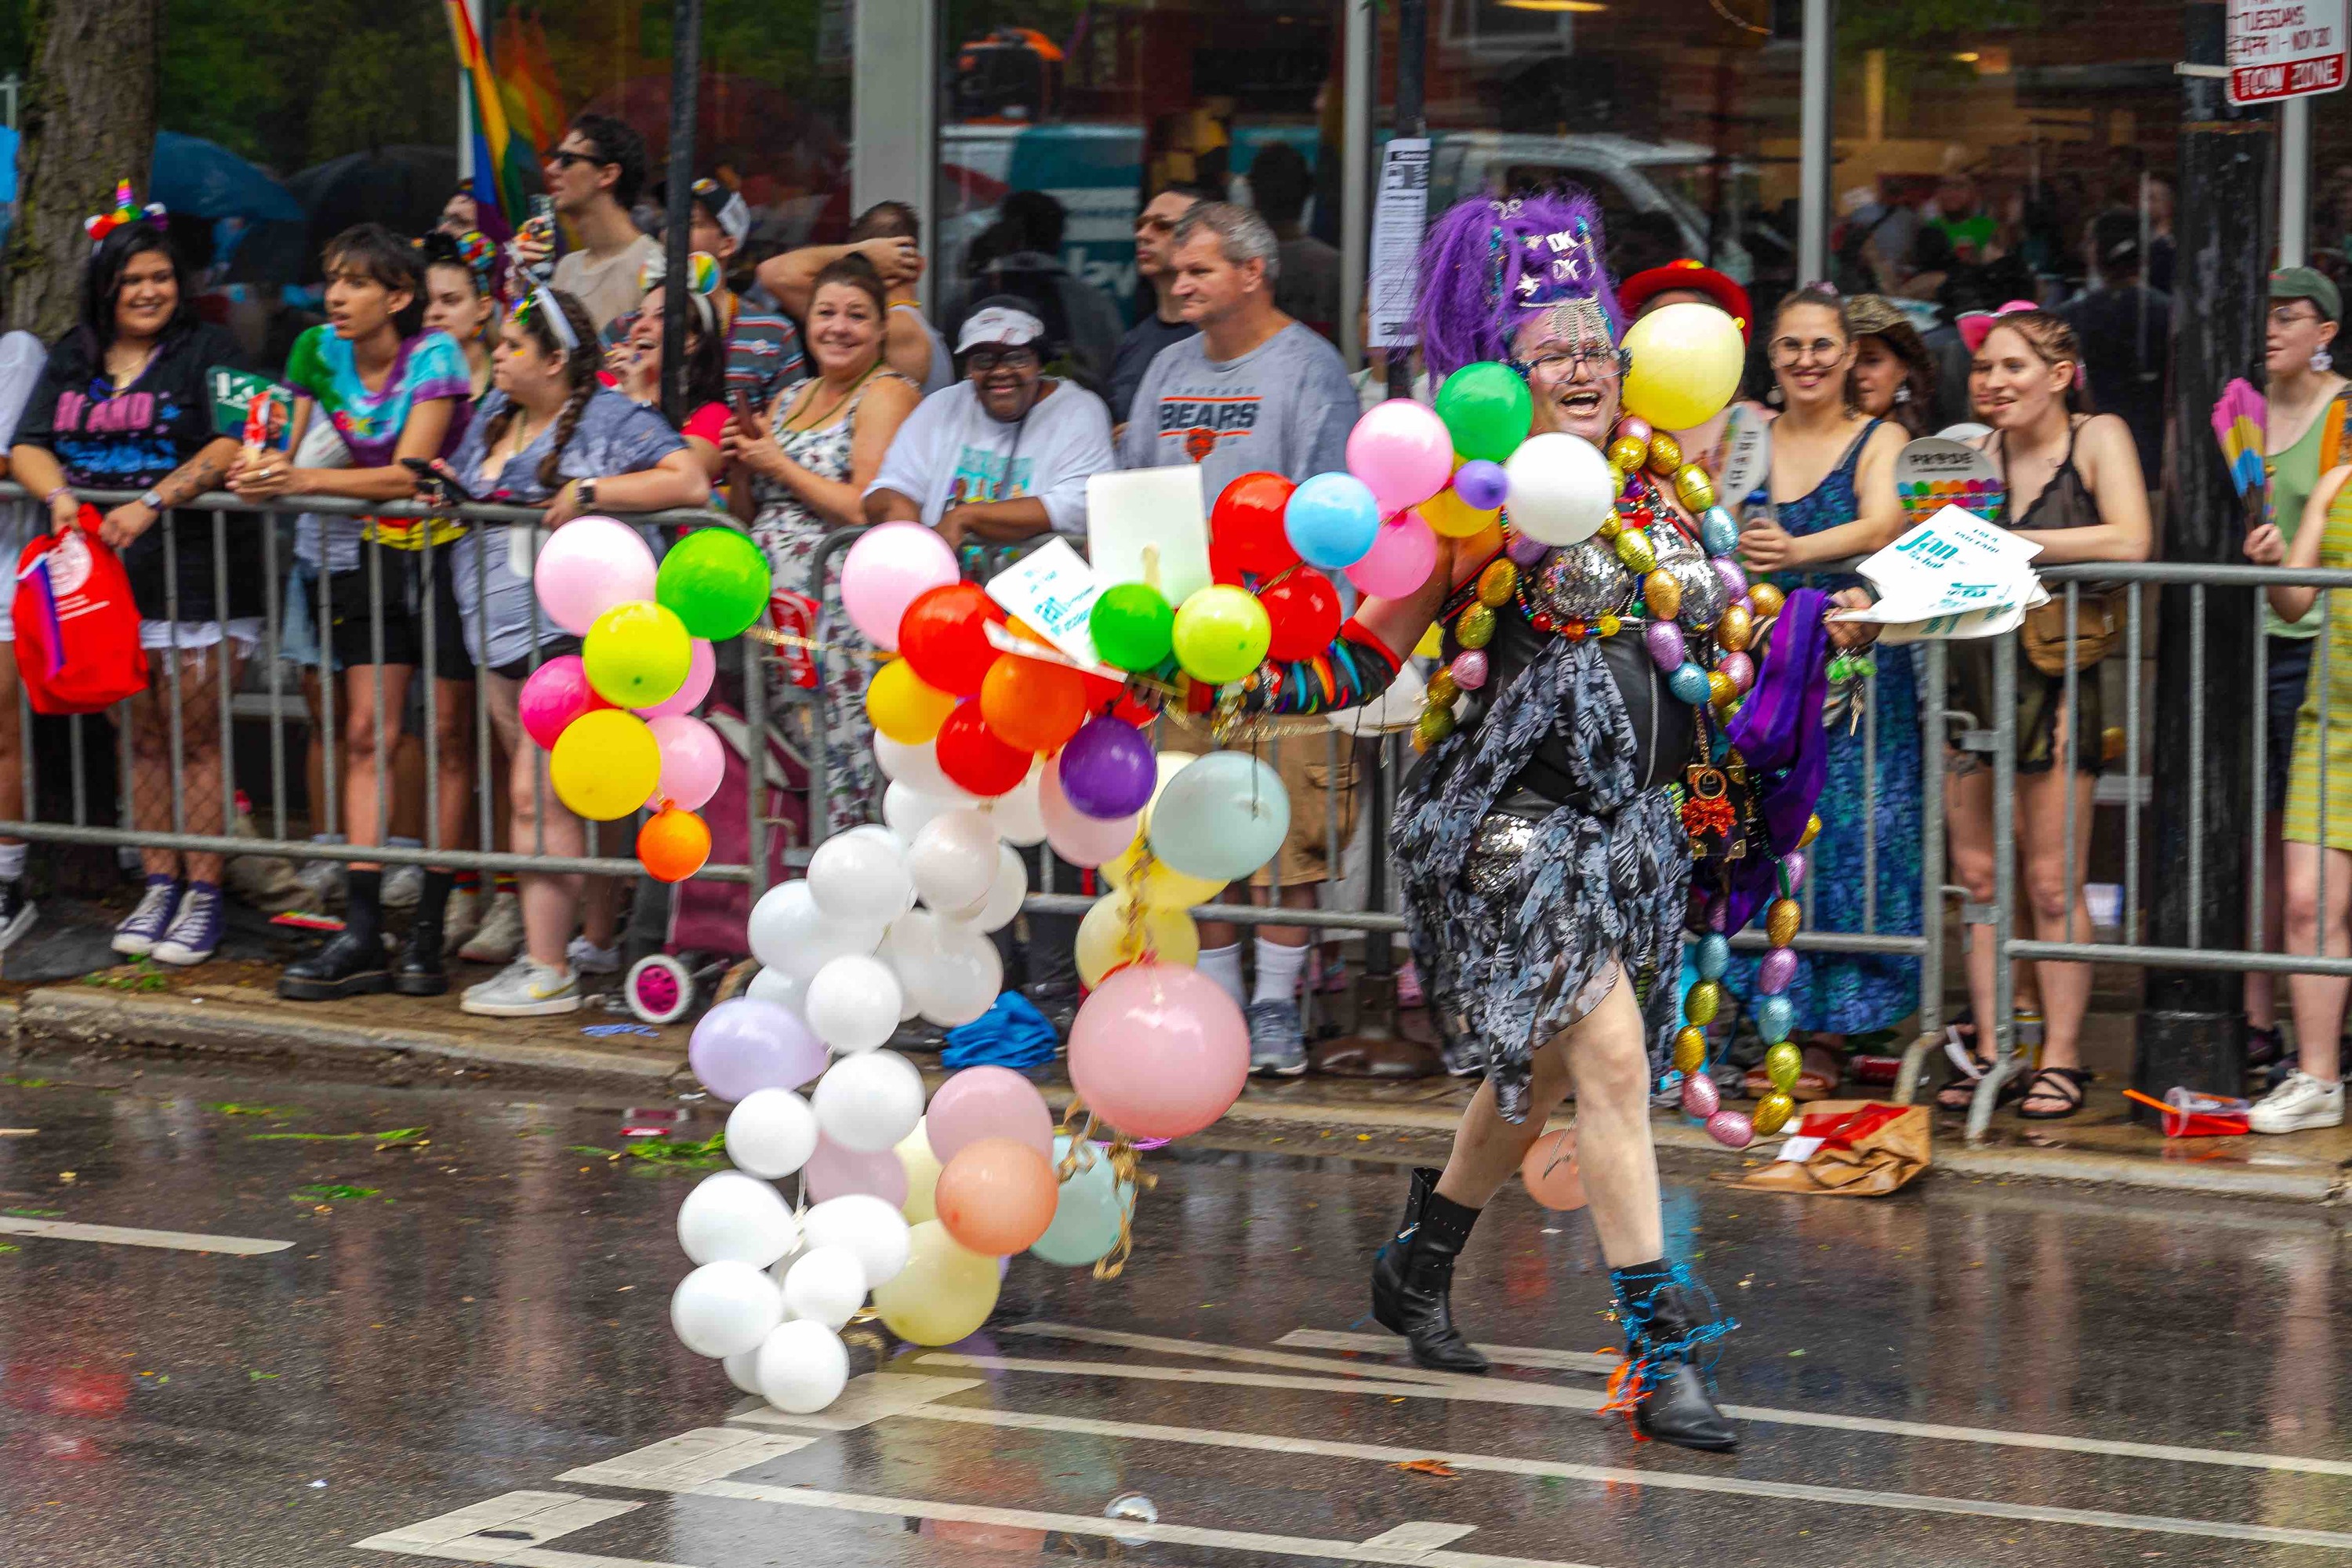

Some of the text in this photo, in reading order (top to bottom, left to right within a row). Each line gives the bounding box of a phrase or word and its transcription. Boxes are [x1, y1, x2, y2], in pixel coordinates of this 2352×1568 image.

[2238, 58, 2339, 97] TOW ZONE
[1159, 402, 1261, 430] BEARS
[1895, 529, 1959, 560] Jan
